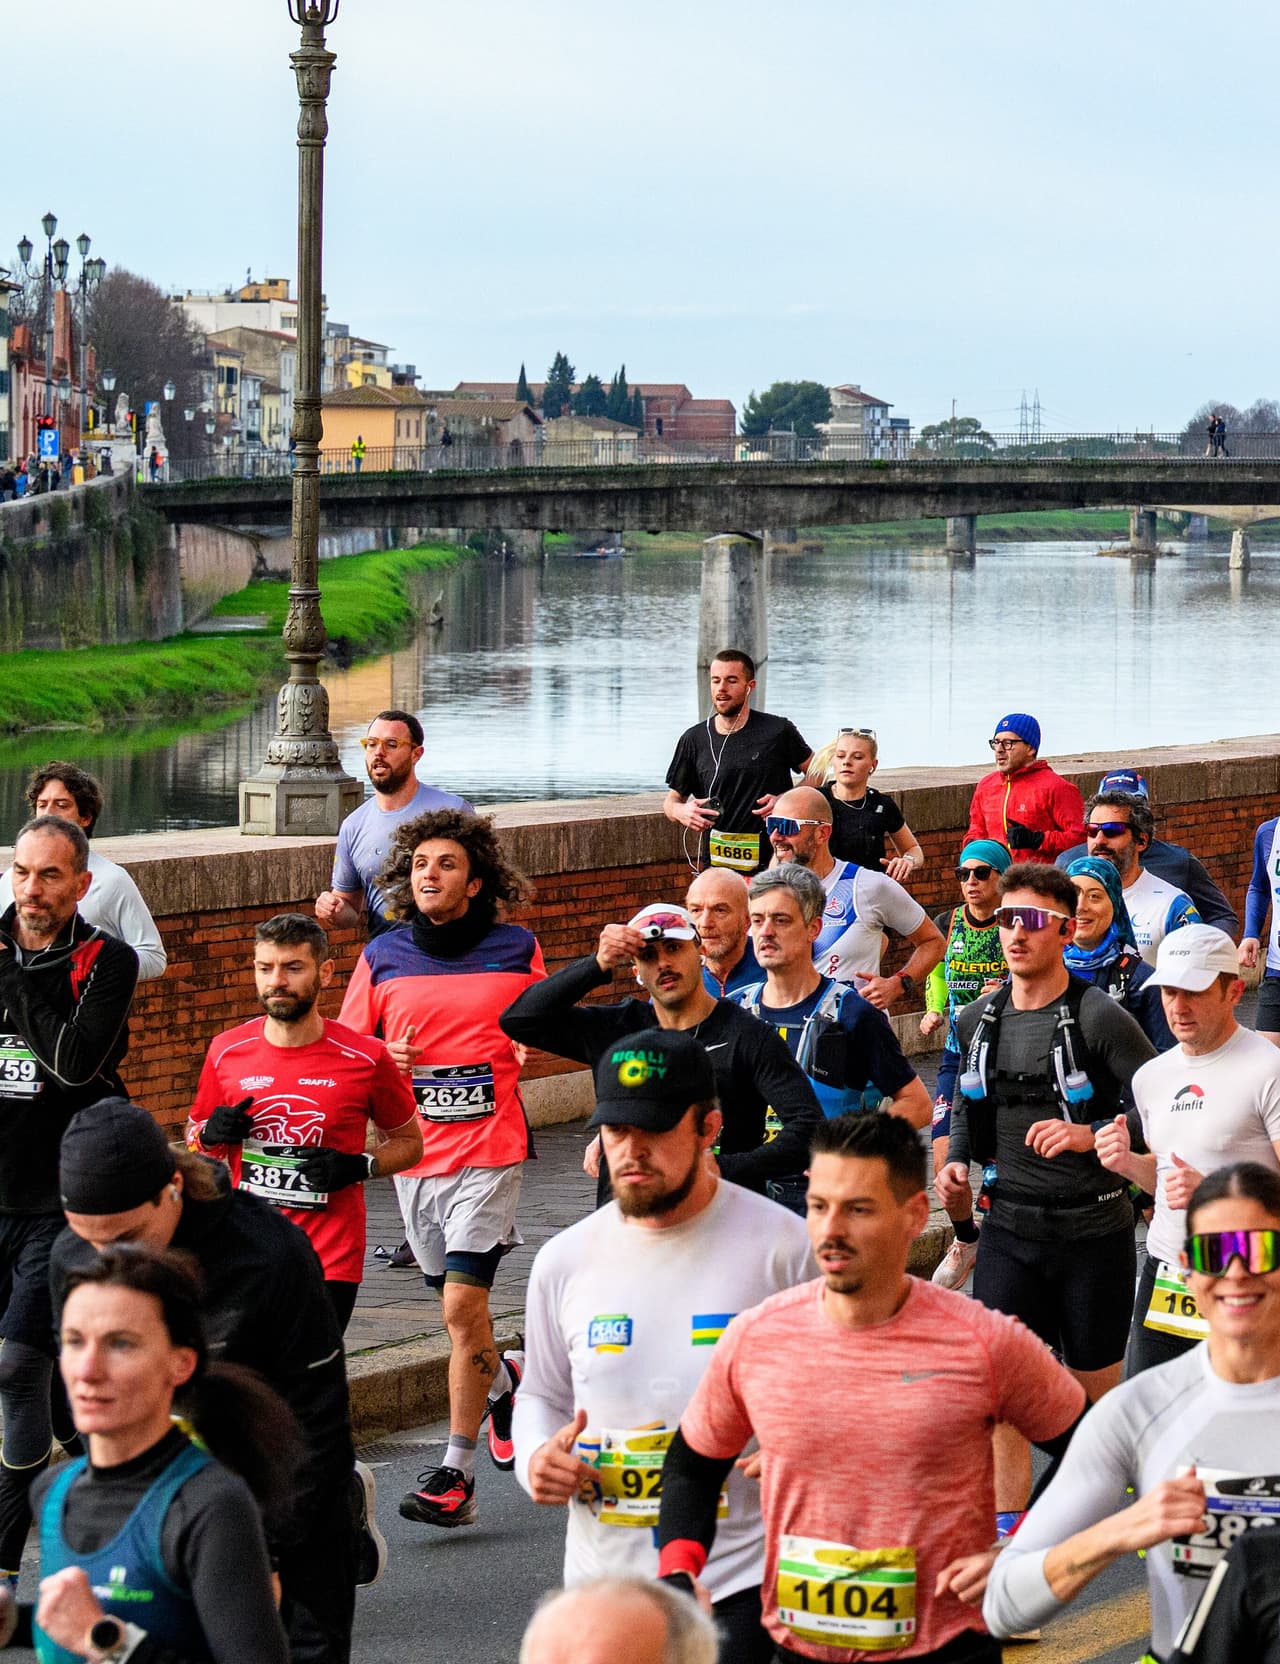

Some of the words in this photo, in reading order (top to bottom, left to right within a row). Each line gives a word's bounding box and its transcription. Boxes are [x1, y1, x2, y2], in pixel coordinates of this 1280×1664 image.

[44, 431, 55, 446] P
[715, 844, 753, 860] 1686
[947, 960, 1010, 973] ATLETICA
[299, 1079, 329, 1087] CRAFT
[421, 1085, 487, 1107] 2624
[1170, 1100, 1204, 1113] skinfit
[590, 1319, 631, 1338] PEACE
[790, 1580, 897, 1619] 1104
